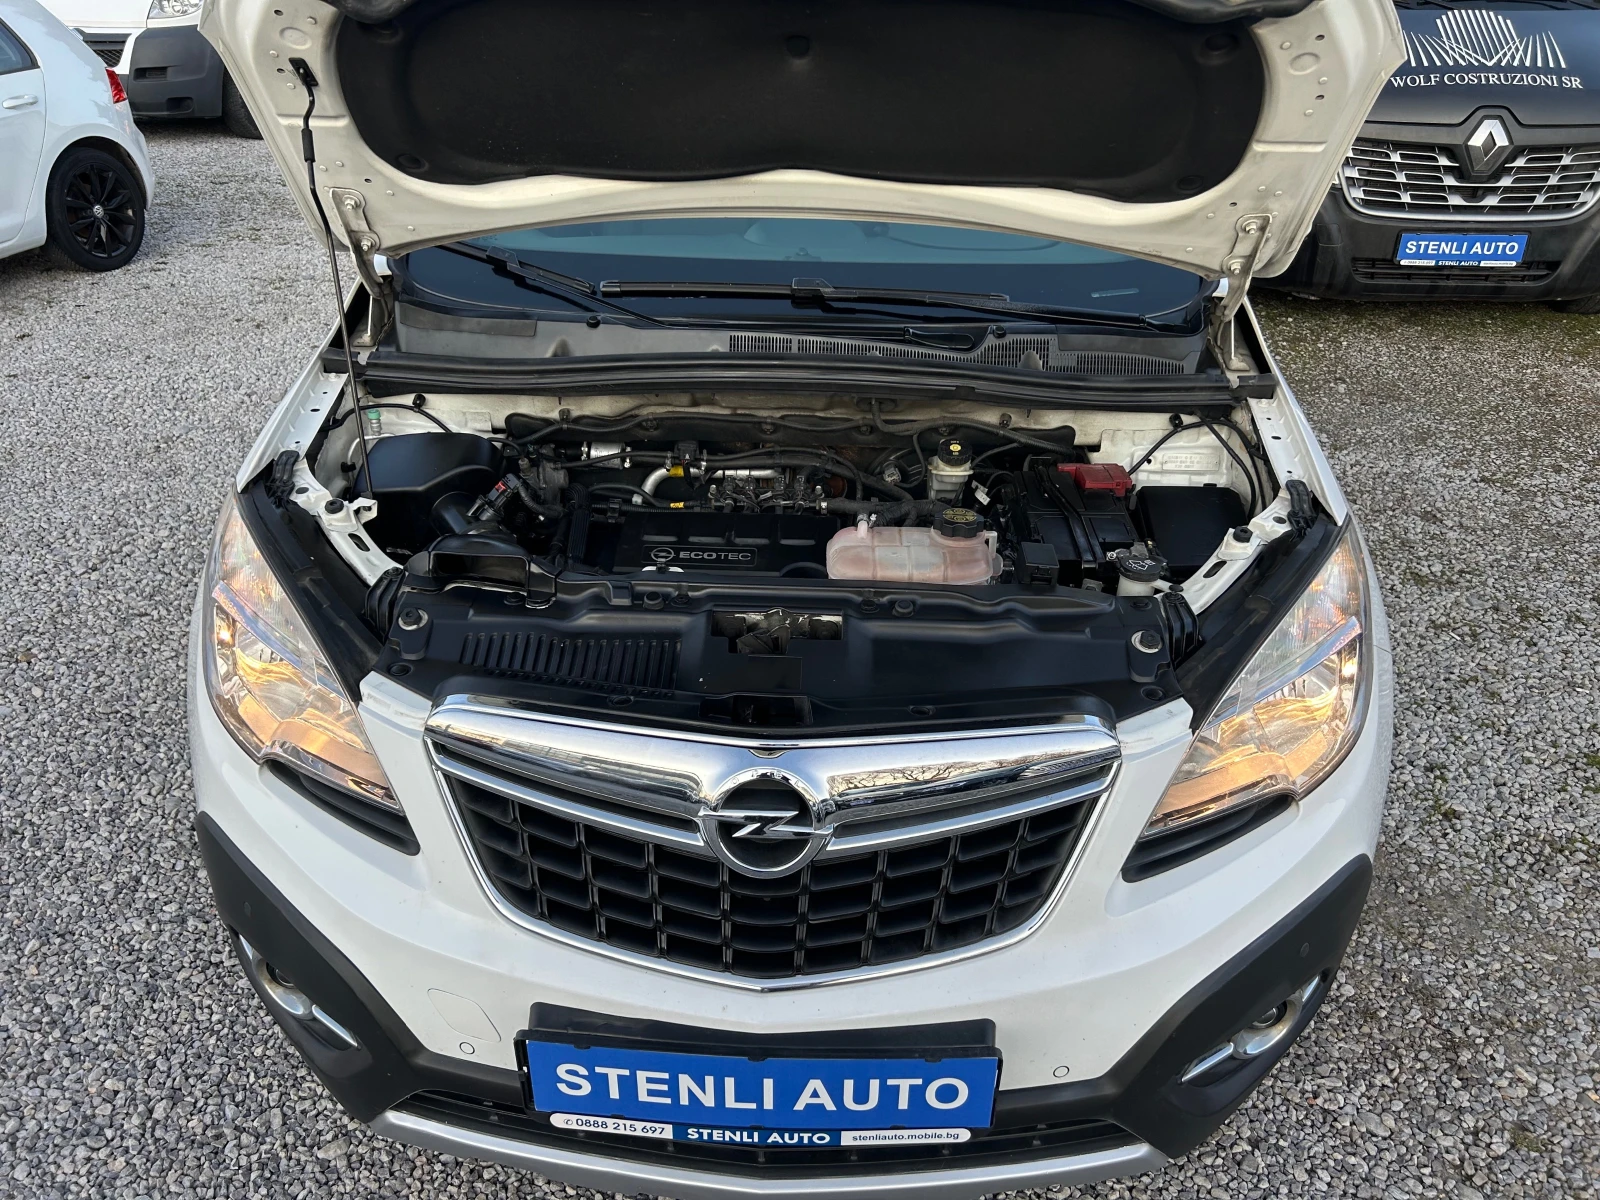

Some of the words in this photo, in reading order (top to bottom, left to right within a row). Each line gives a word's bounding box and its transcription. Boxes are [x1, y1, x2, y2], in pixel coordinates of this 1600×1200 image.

[1390, 74, 1440, 88] WOLF
[1443, 73, 1558, 87] COSTRUZIONI
[1562, 76, 1584, 89] SR
[1405, 241, 1468, 254] STENLI
[1469, 241, 1519, 255] AUTO
[679, 551, 752, 560] ECOTEC
[555, 1063, 774, 1111] STENLI
[793, 1077, 969, 1111] AUTO
[575, 1118, 609, 1129] 0888
[612, 1121, 637, 1132] 215
[641, 1125, 665, 1135] 697
[687, 1128, 759, 1143] STENLI
[766, 1132, 831, 1144] AUTO
[852, 1131, 960, 1142] stenliauto.mobile.bg
